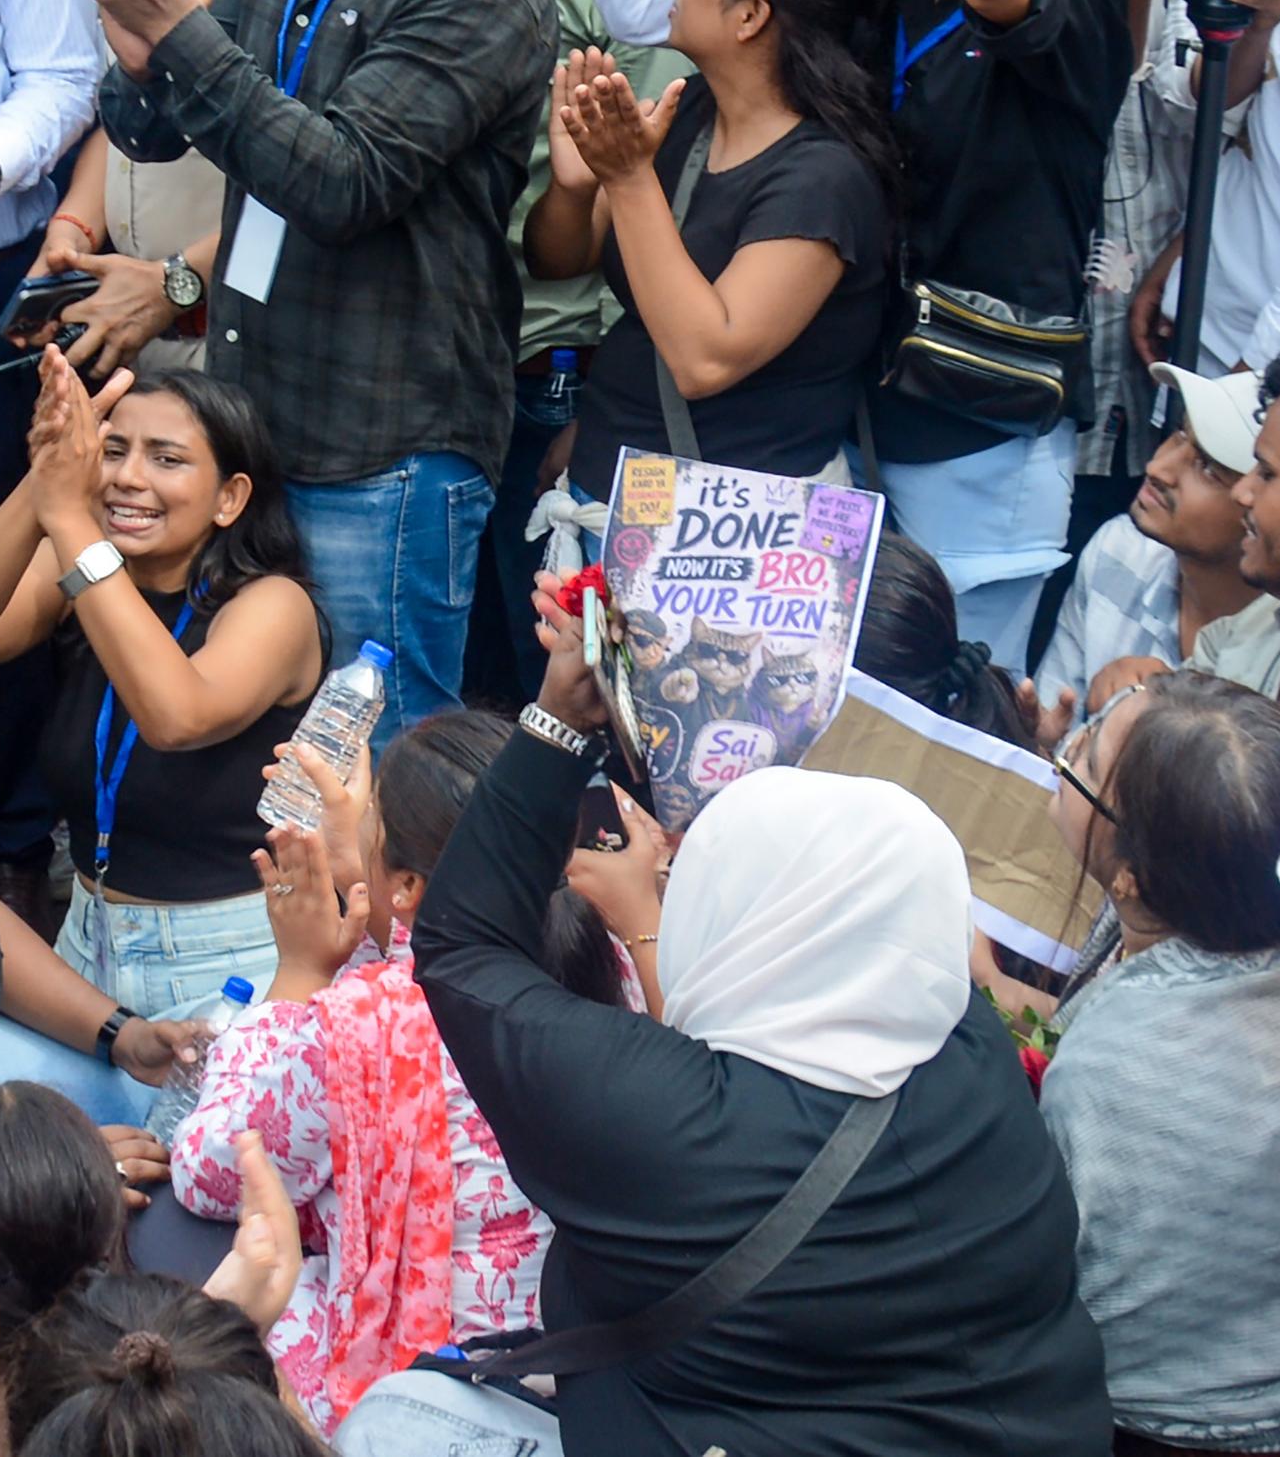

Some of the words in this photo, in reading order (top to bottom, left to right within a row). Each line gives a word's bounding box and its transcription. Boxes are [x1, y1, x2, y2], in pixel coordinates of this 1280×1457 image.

[698, 477, 751, 508] it's
[670, 509, 801, 553] DONE
[665, 559, 710, 579] NOW
[710, 559, 744, 580] IT'S
[756, 551, 830, 590] BRO,
[651, 584, 739, 619] YOUR
[746, 595, 829, 632] TURN
[707, 729, 759, 757] Sai
[697, 757, 747, 782] Sai
